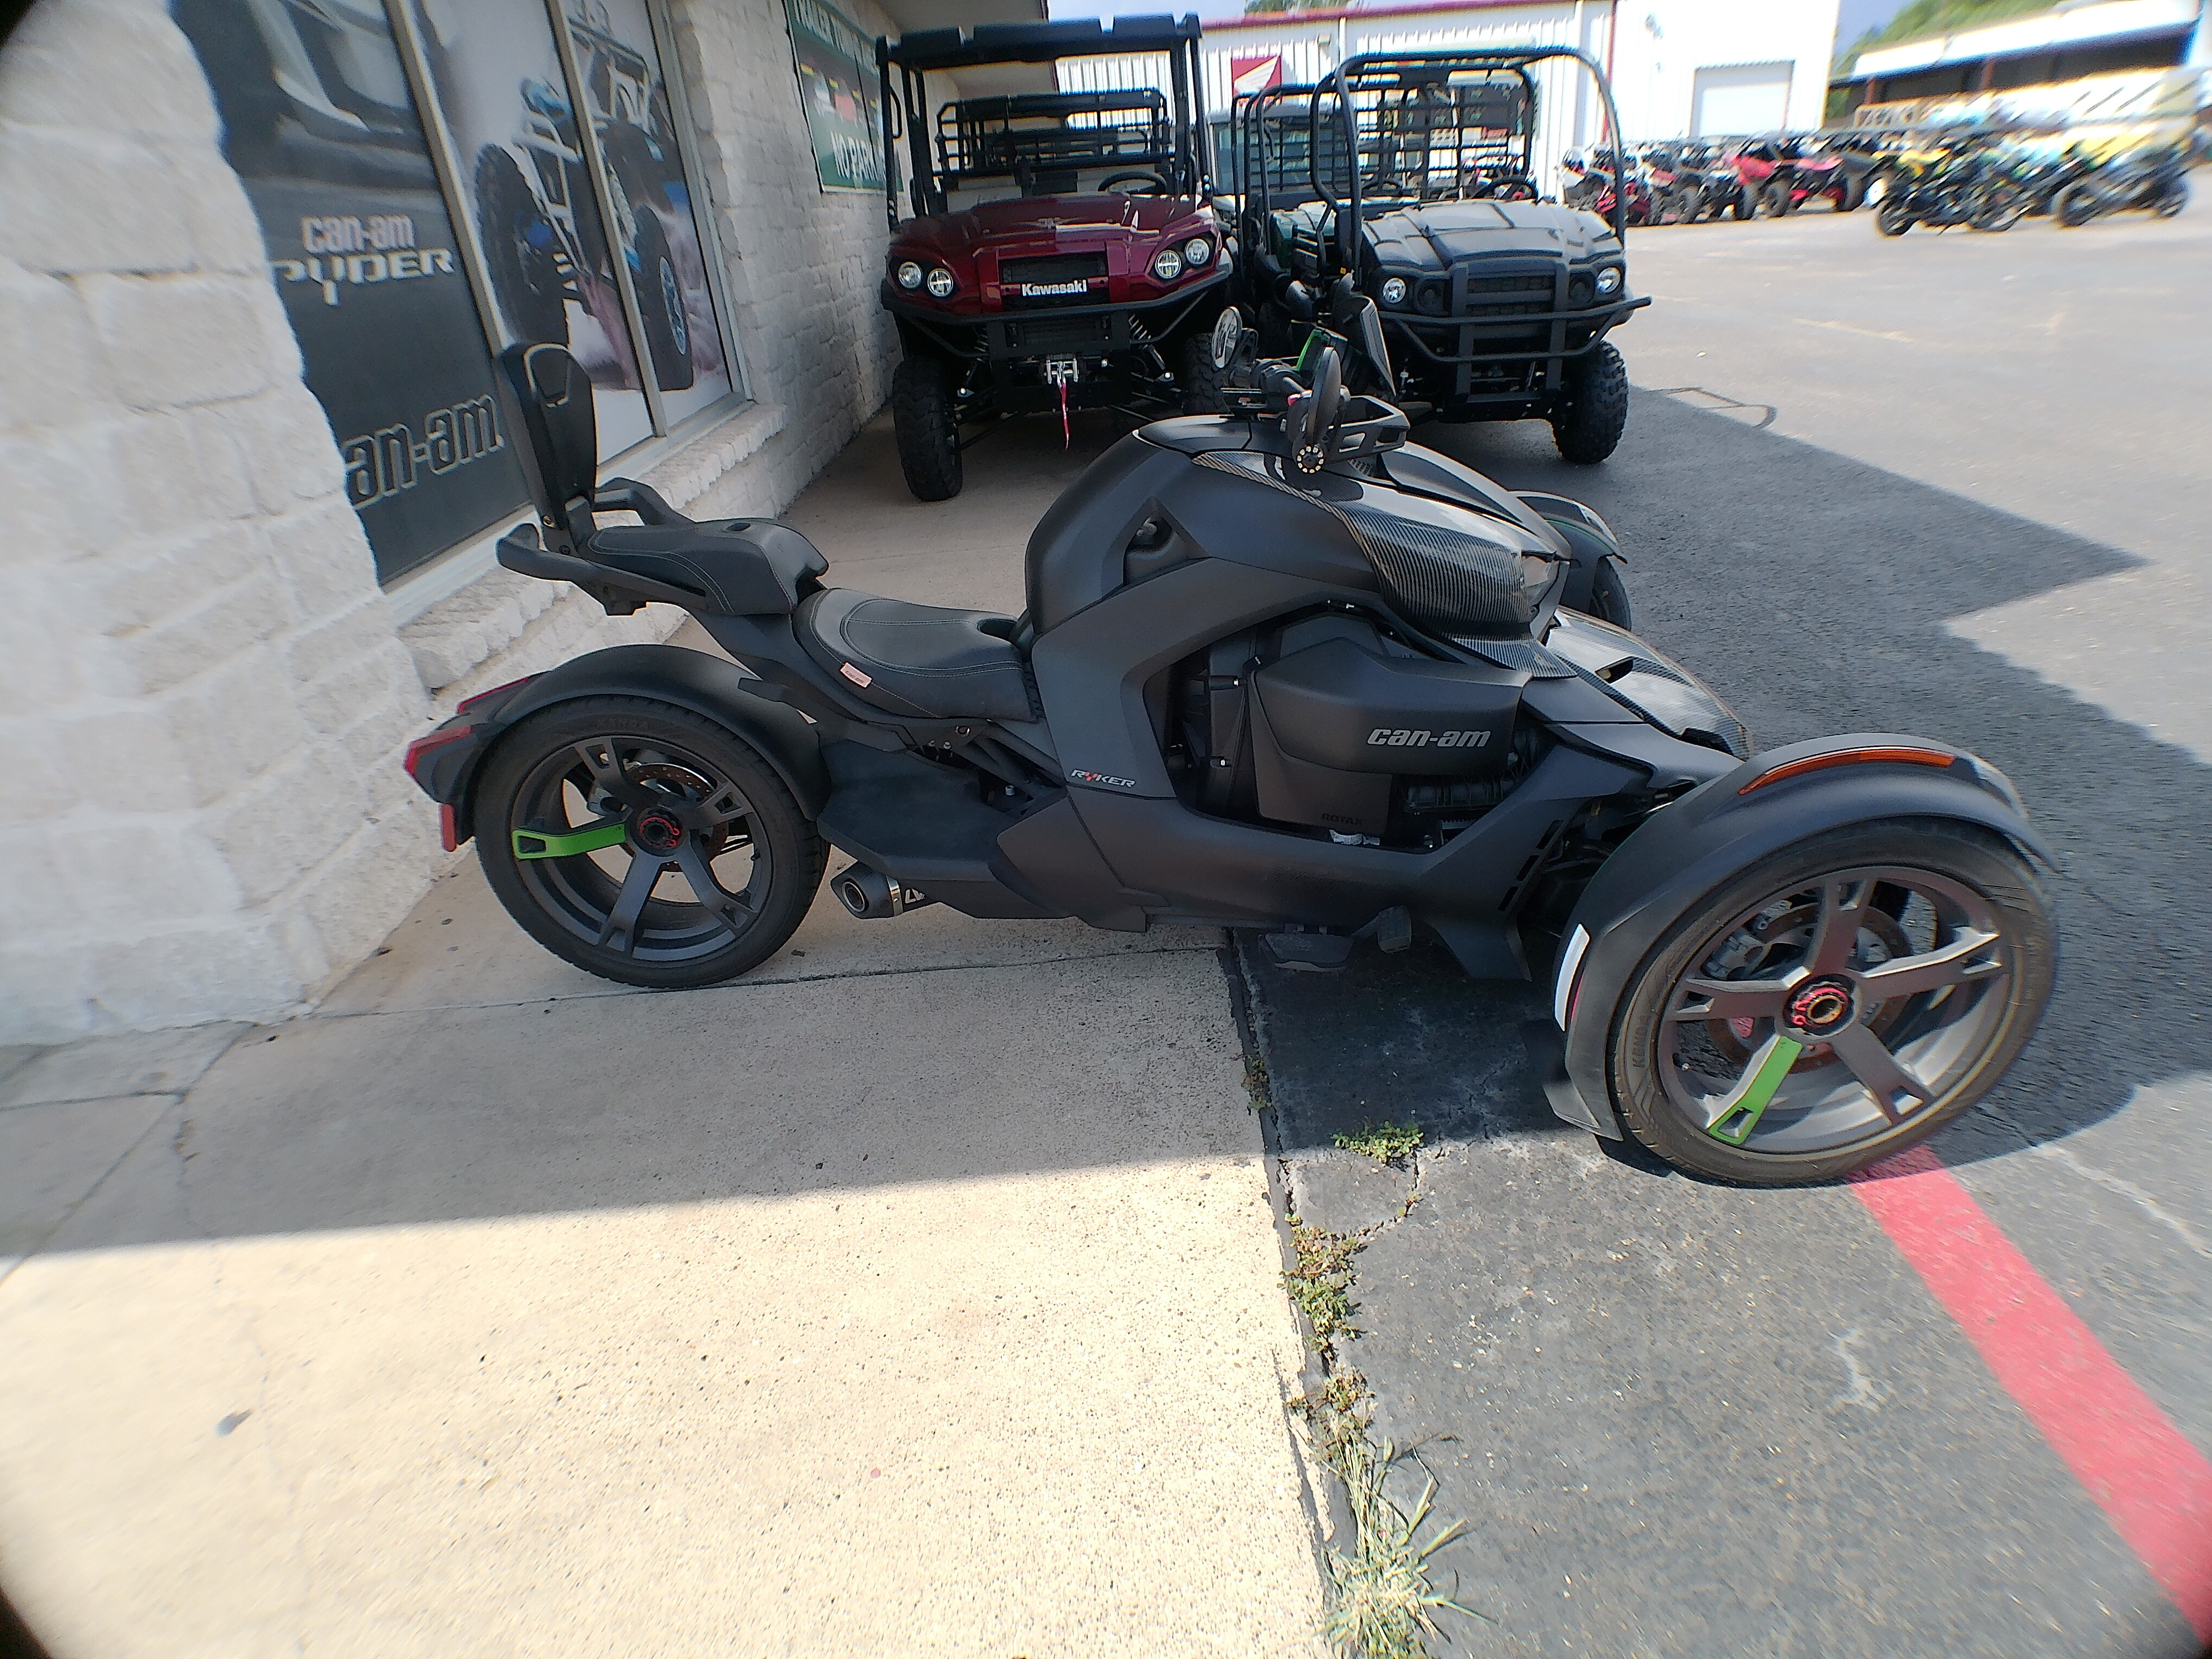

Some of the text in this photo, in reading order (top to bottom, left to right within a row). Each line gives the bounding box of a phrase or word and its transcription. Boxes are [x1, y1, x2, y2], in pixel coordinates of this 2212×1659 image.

[831, 131, 851, 179] NO
[301, 215, 415, 254] can-am
[1022, 280, 1087, 296] Kawasaki
[342, 394, 506, 510] an-am
[1367, 729, 1491, 747] can-am
[1071, 769, 1136, 788] RYKER
